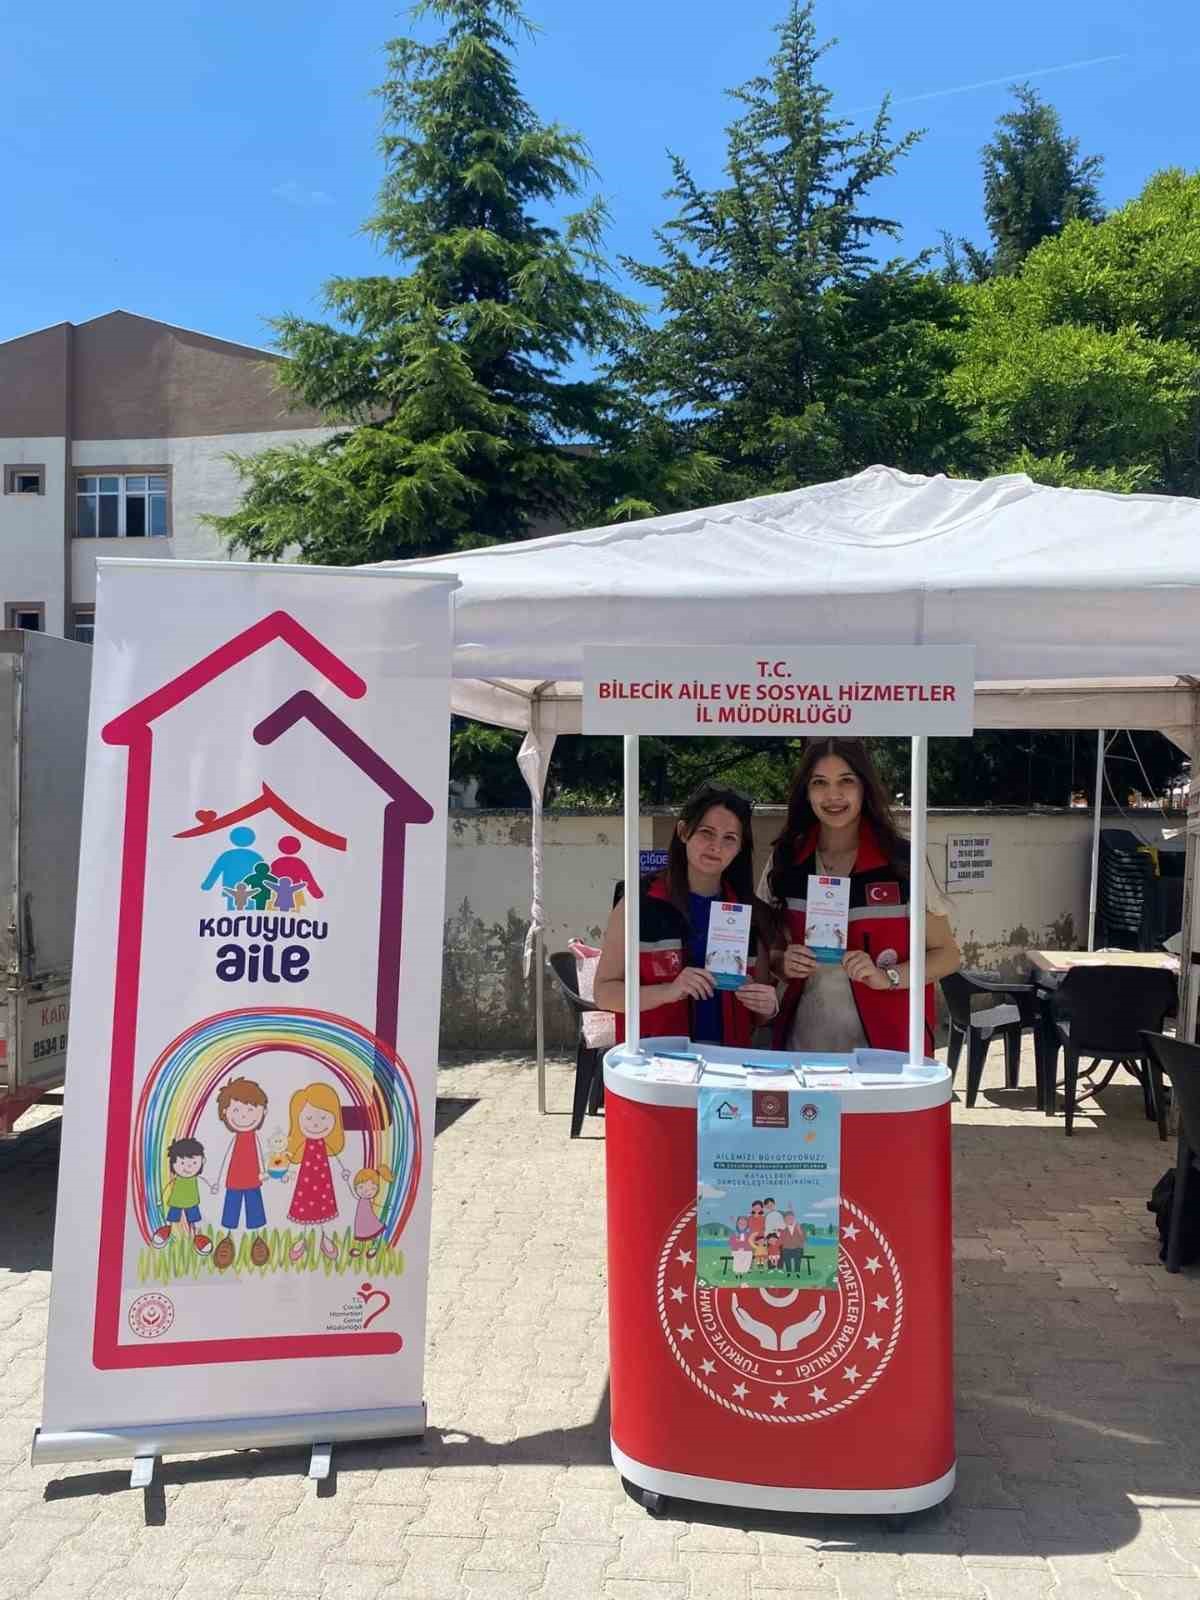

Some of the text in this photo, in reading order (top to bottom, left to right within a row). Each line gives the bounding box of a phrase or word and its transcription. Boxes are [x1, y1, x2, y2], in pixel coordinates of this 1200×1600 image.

[756, 661, 791, 678] T.C.
[598, 679, 956, 702] BİLECİK AİLE VE SOSYAL HİZMETLER
[696, 703, 852, 724] İL MÜDÜRLÜĞÜ
[640, 852, 669, 866] ÇİĞDE
[41, 1004, 69, 1026] KAR
[699, 1288, 760, 1376] TÜRKİYE CUMH
[796, 1326, 854, 1378] BAKANLIĞI
